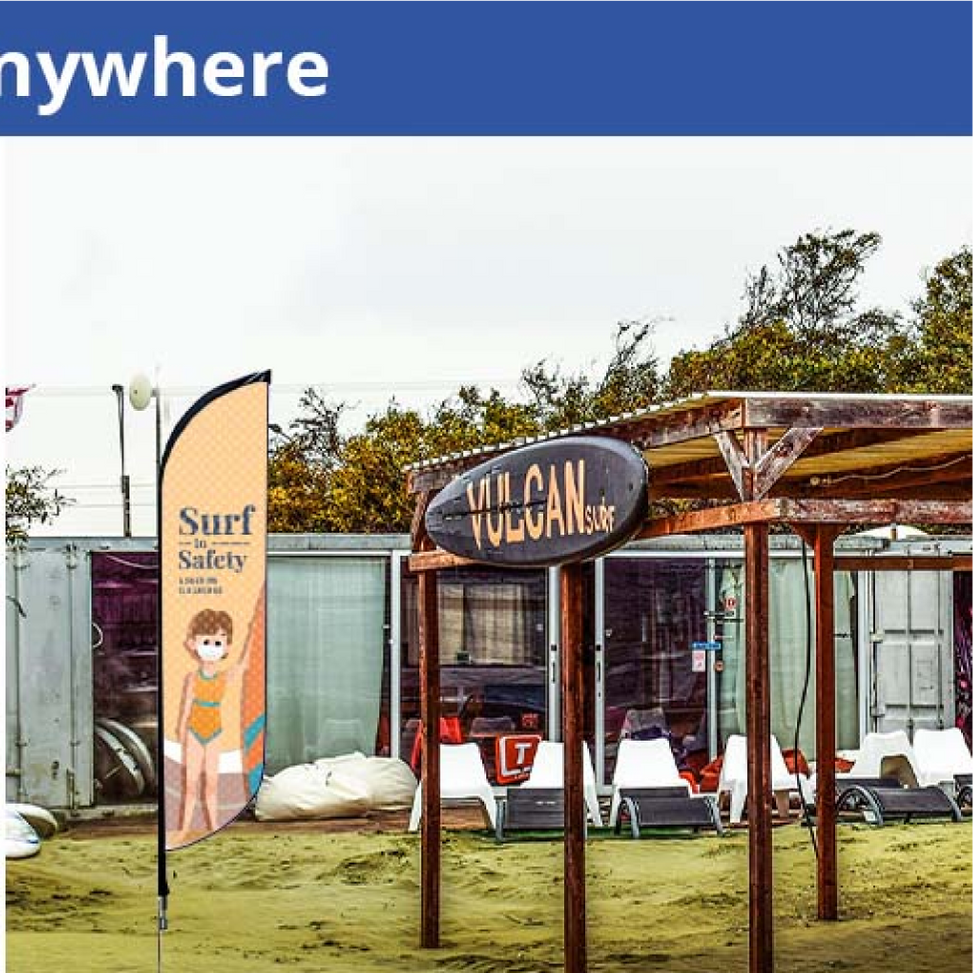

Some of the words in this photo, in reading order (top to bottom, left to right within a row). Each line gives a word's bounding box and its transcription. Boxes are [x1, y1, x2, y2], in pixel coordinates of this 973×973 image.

[179, 504, 256, 535] Surf
[466, 459, 586, 550] VULCAN
[178, 549, 248, 573] Safety
